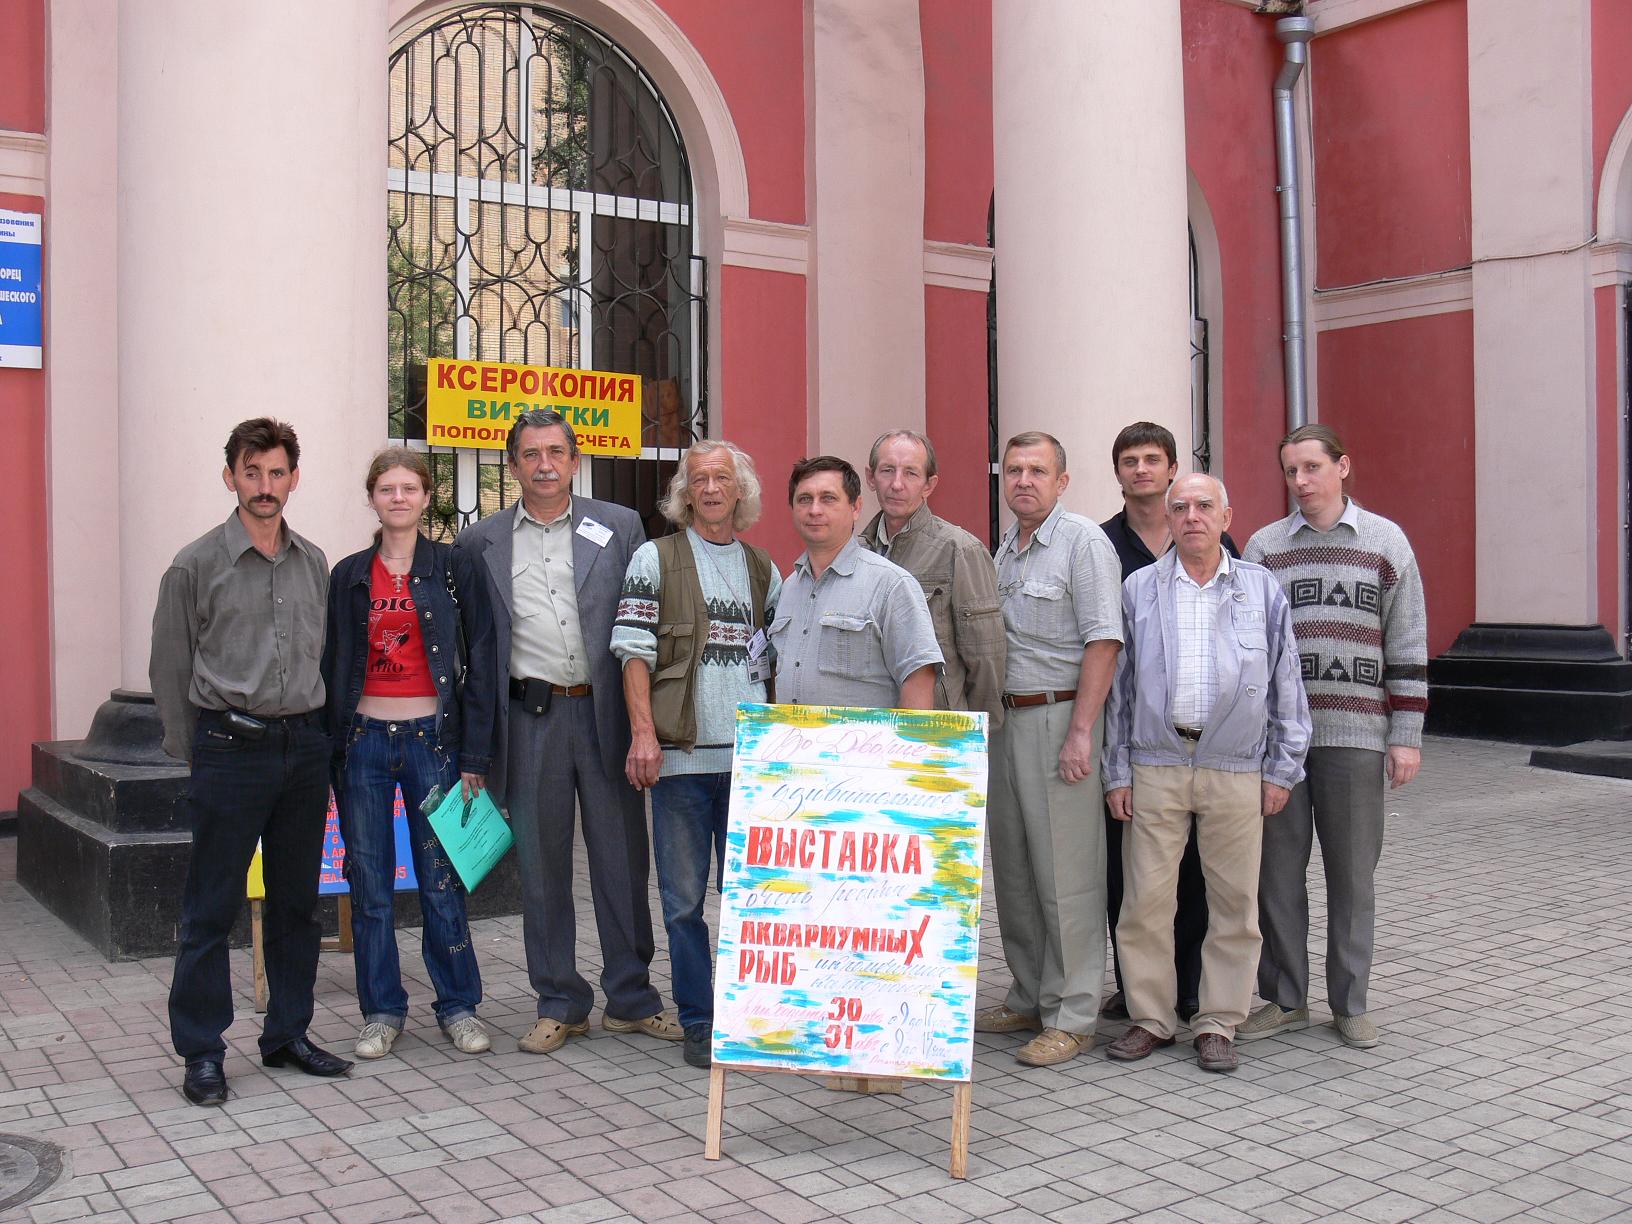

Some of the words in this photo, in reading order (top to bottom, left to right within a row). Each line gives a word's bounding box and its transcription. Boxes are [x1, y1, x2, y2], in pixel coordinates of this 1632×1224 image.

[437, 363, 634, 402] КСЕРОКОПИЯ
[467, 399, 610, 427] ВИЗТКИ
[747, 825, 922, 875] ВЫСТАВКА
[740, 914, 931, 966] АКВАРИУМНЫХ
[738, 949, 797, 985] РЫБ
[828, 996, 863, 1022] 30
[825, 1023, 854, 1049] 31
